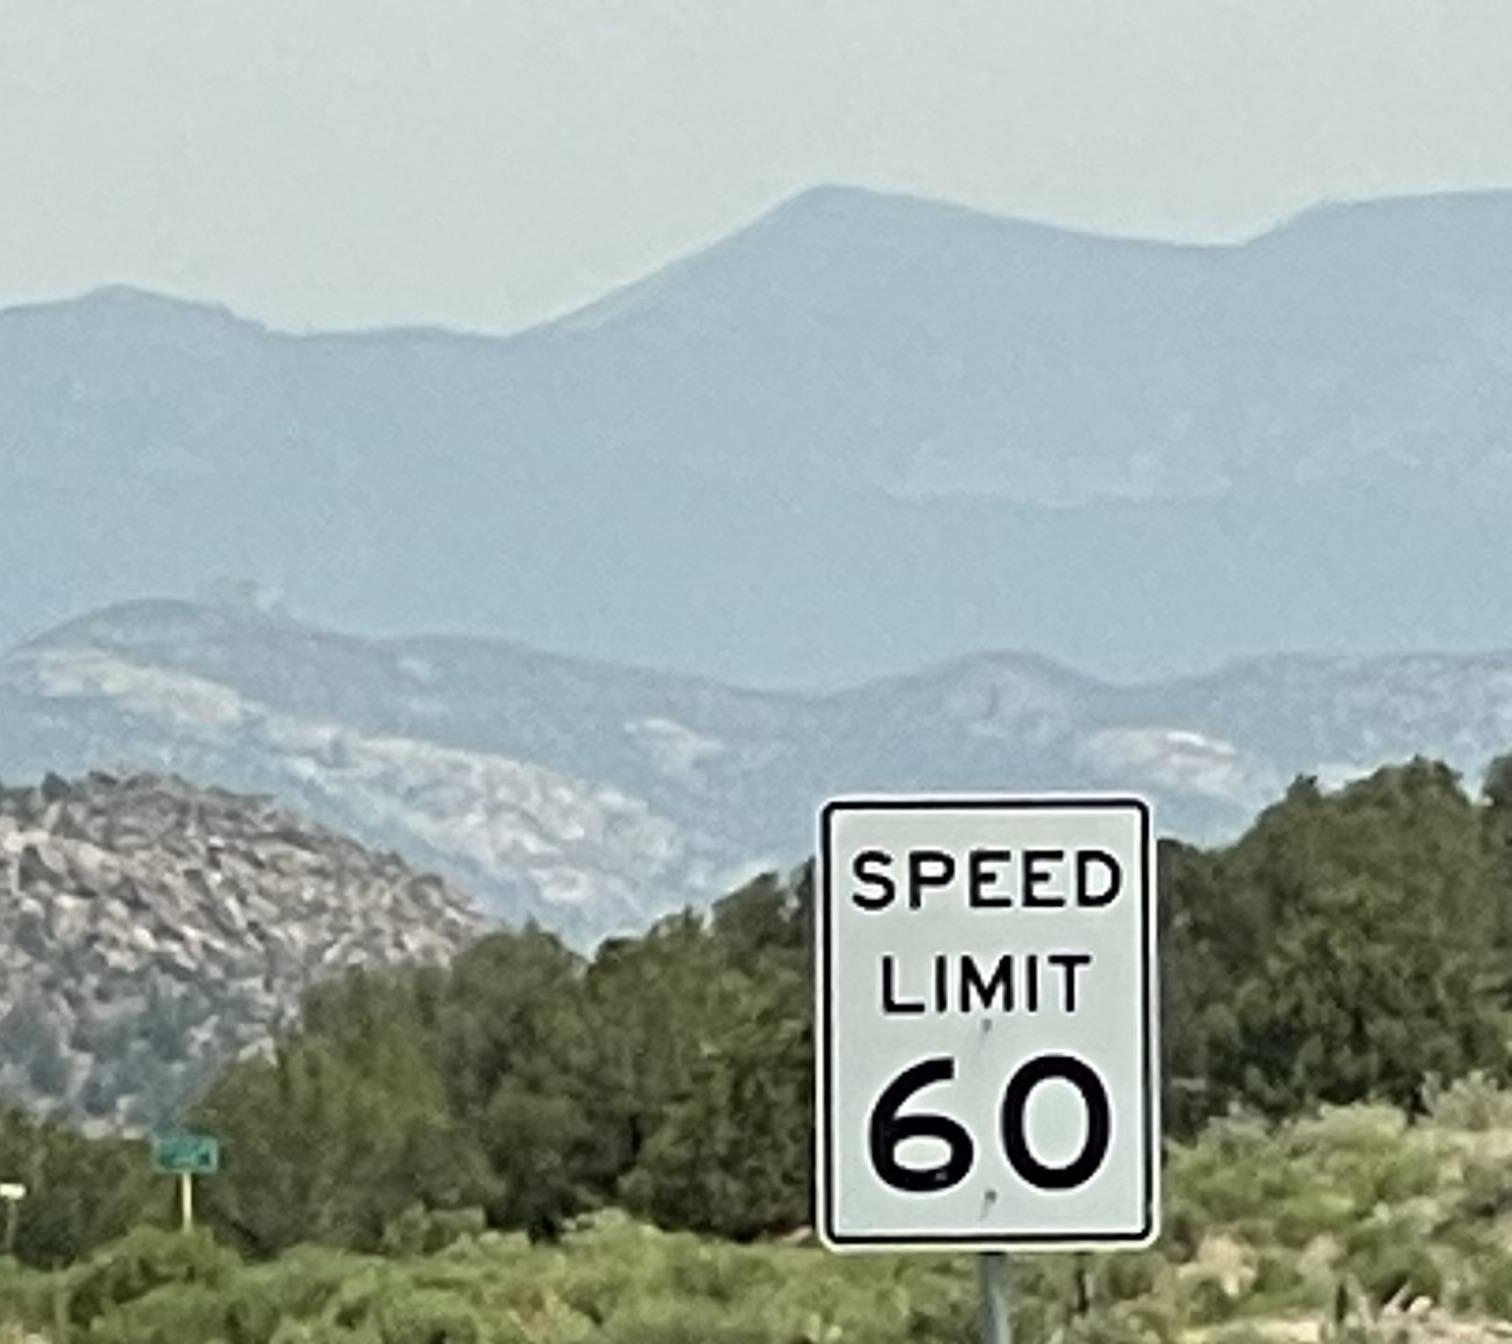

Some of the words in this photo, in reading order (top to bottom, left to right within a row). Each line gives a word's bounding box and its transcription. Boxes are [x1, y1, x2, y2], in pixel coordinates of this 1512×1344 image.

[851, 849, 1122, 911] SPEED
[881, 954, 1092, 1013] LIMIT
[868, 1054, 1112, 1193] 60
